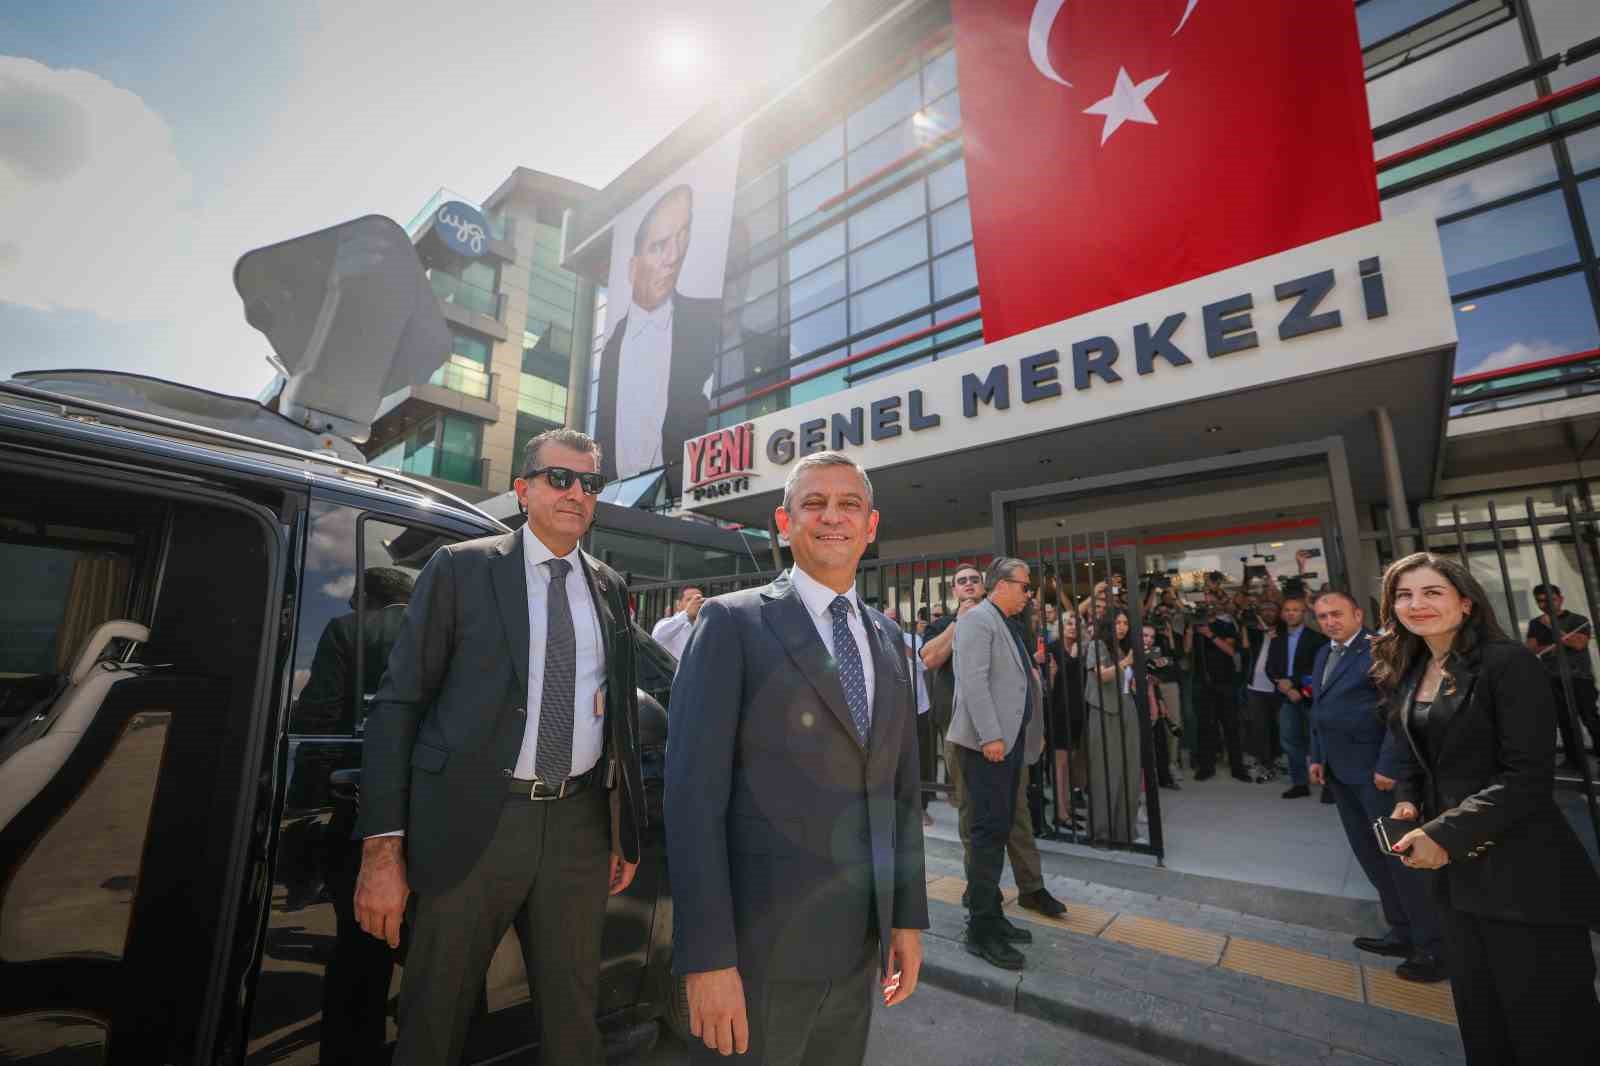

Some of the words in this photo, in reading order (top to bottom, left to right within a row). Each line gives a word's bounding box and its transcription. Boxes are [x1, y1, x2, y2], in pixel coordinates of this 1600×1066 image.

[766, 389, 941, 465] GENEL
[962, 256, 1389, 418] MERKEZİ
[687, 422, 754, 484] YENİ
